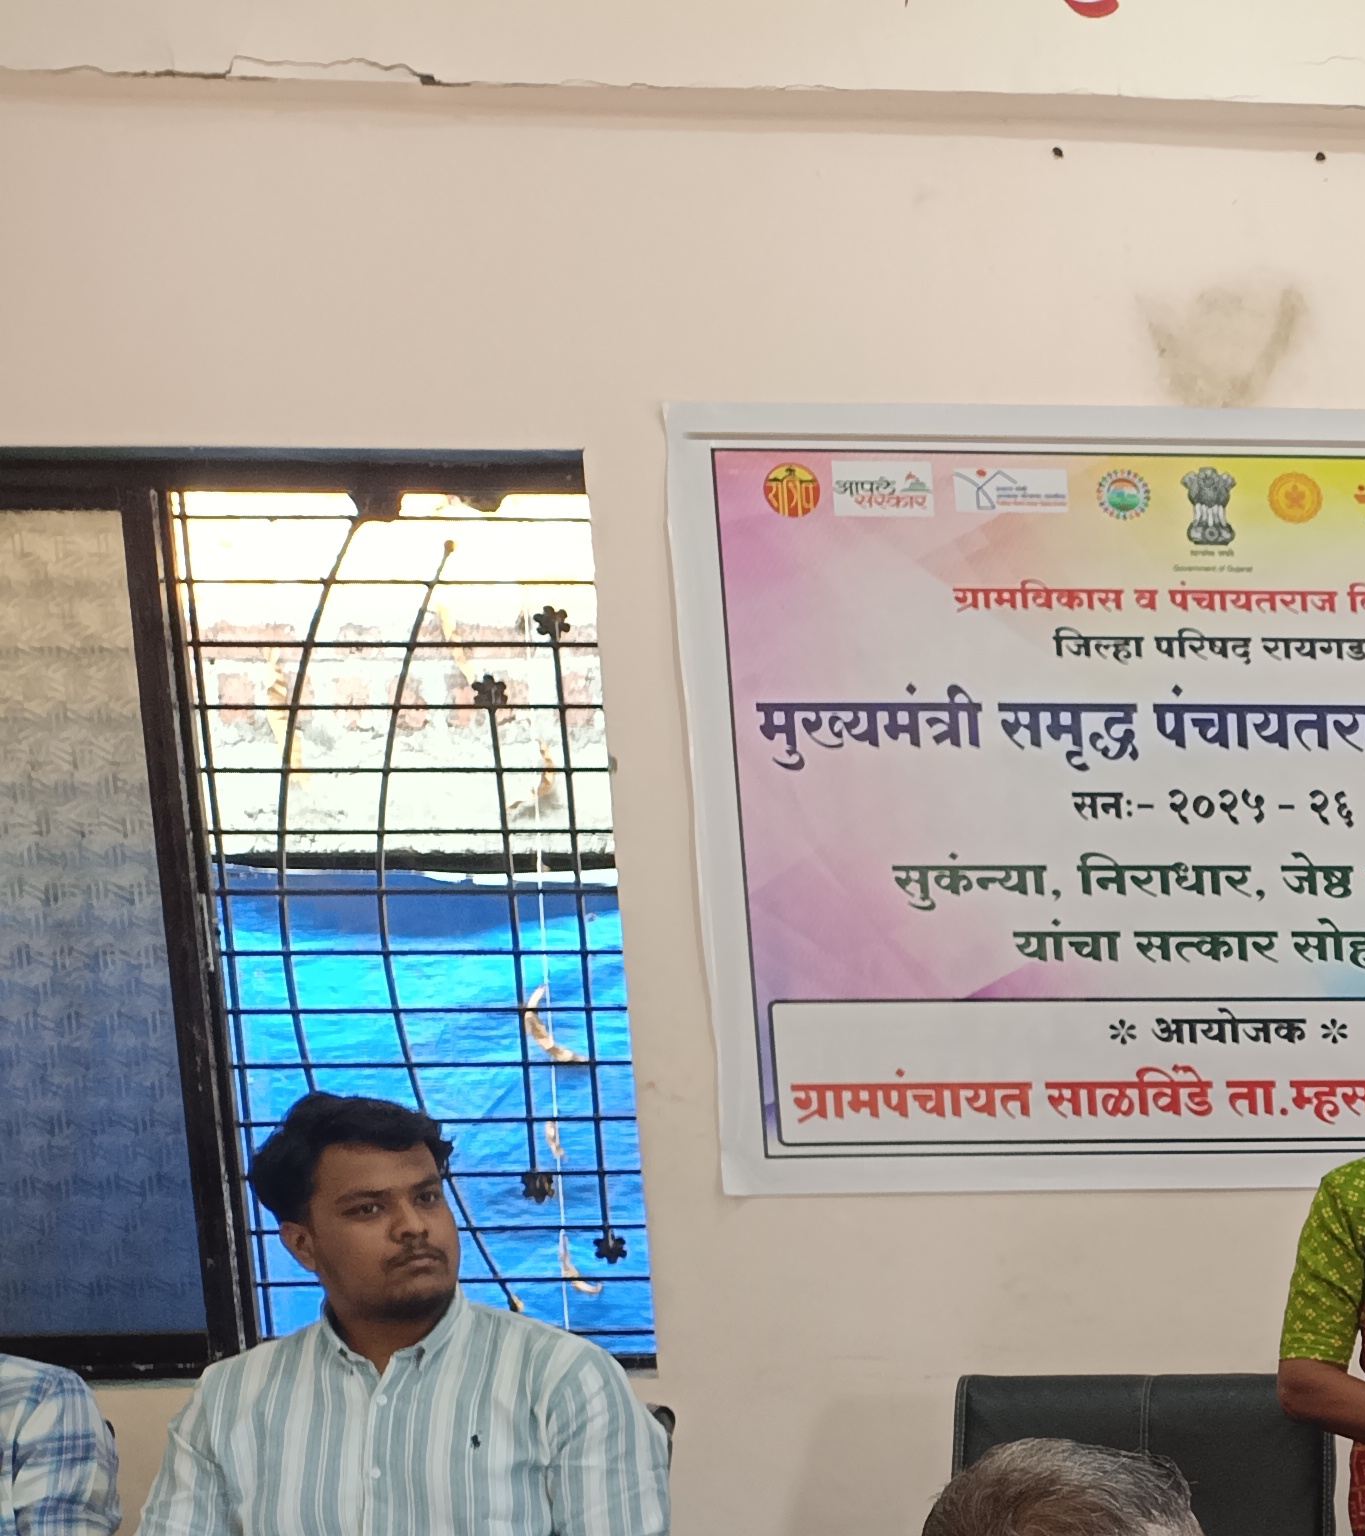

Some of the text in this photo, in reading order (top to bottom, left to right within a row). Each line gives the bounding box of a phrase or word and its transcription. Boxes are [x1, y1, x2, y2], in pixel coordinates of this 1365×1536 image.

[953, 579, 1124, 614] ग्रामविकास
[1134, 587, 1159, 613] व
[1168, 580, 1337, 615] पंचायतराज
[1052, 627, 1144, 666] जिल्हा
[1154, 630, 1252, 668] परिषद
[756, 682, 984, 771] मुख्यमंत्री
[997, 702, 1140, 772] समृद्ध
[1168, 788, 1266, 826] २०२५
[1308, 789, 1356, 828] २६
[892, 852, 1063, 911] सुकंन्या,
[1076, 852, 1267, 902] निराधार,
[1280, 851, 1355, 899] जेष्ठ
[1012, 919, 1122, 962] यांचा
[1133, 930, 1279, 963] सत्कार
[1151, 1008, 1306, 1045] आयोजक
[790, 1068, 1033, 1124] ग्रामपंचायत
